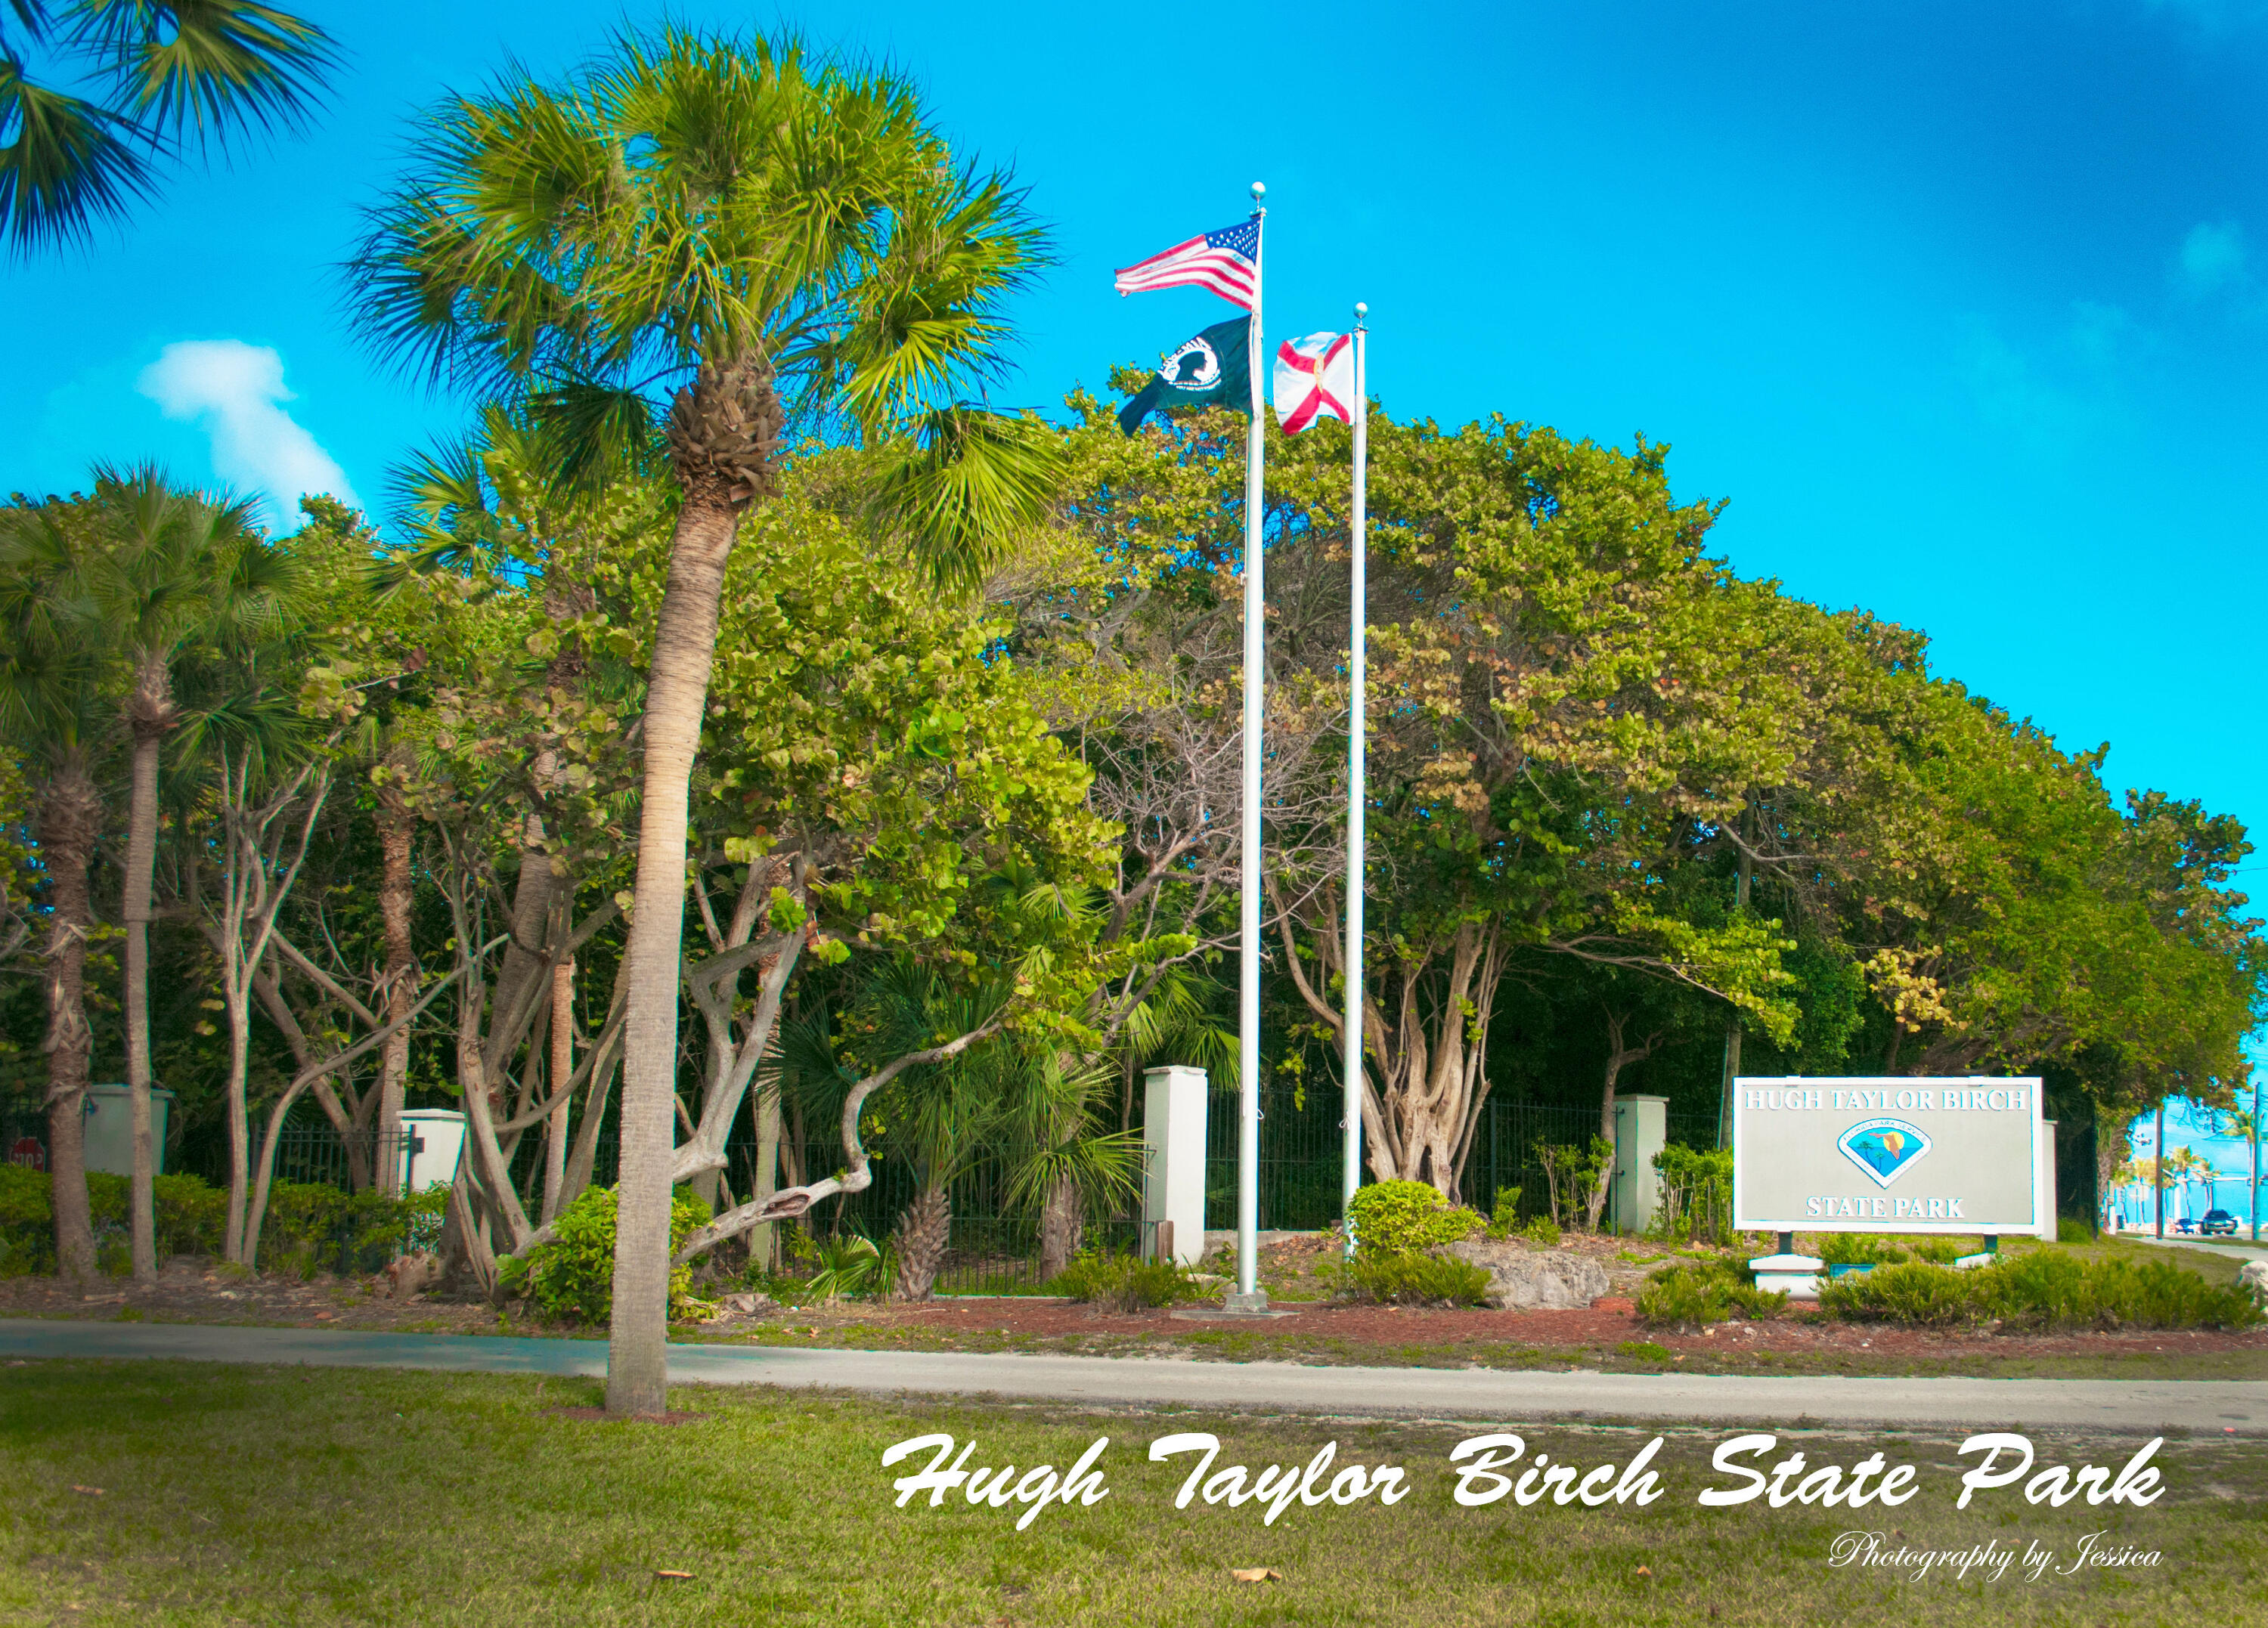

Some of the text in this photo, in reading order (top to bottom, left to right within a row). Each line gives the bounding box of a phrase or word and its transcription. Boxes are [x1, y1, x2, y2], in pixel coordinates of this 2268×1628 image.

[1746, 1089, 2027, 1111] HUGH TAYLOR BIRCH
[1806, 1196, 1966, 1218] STATE PARK
